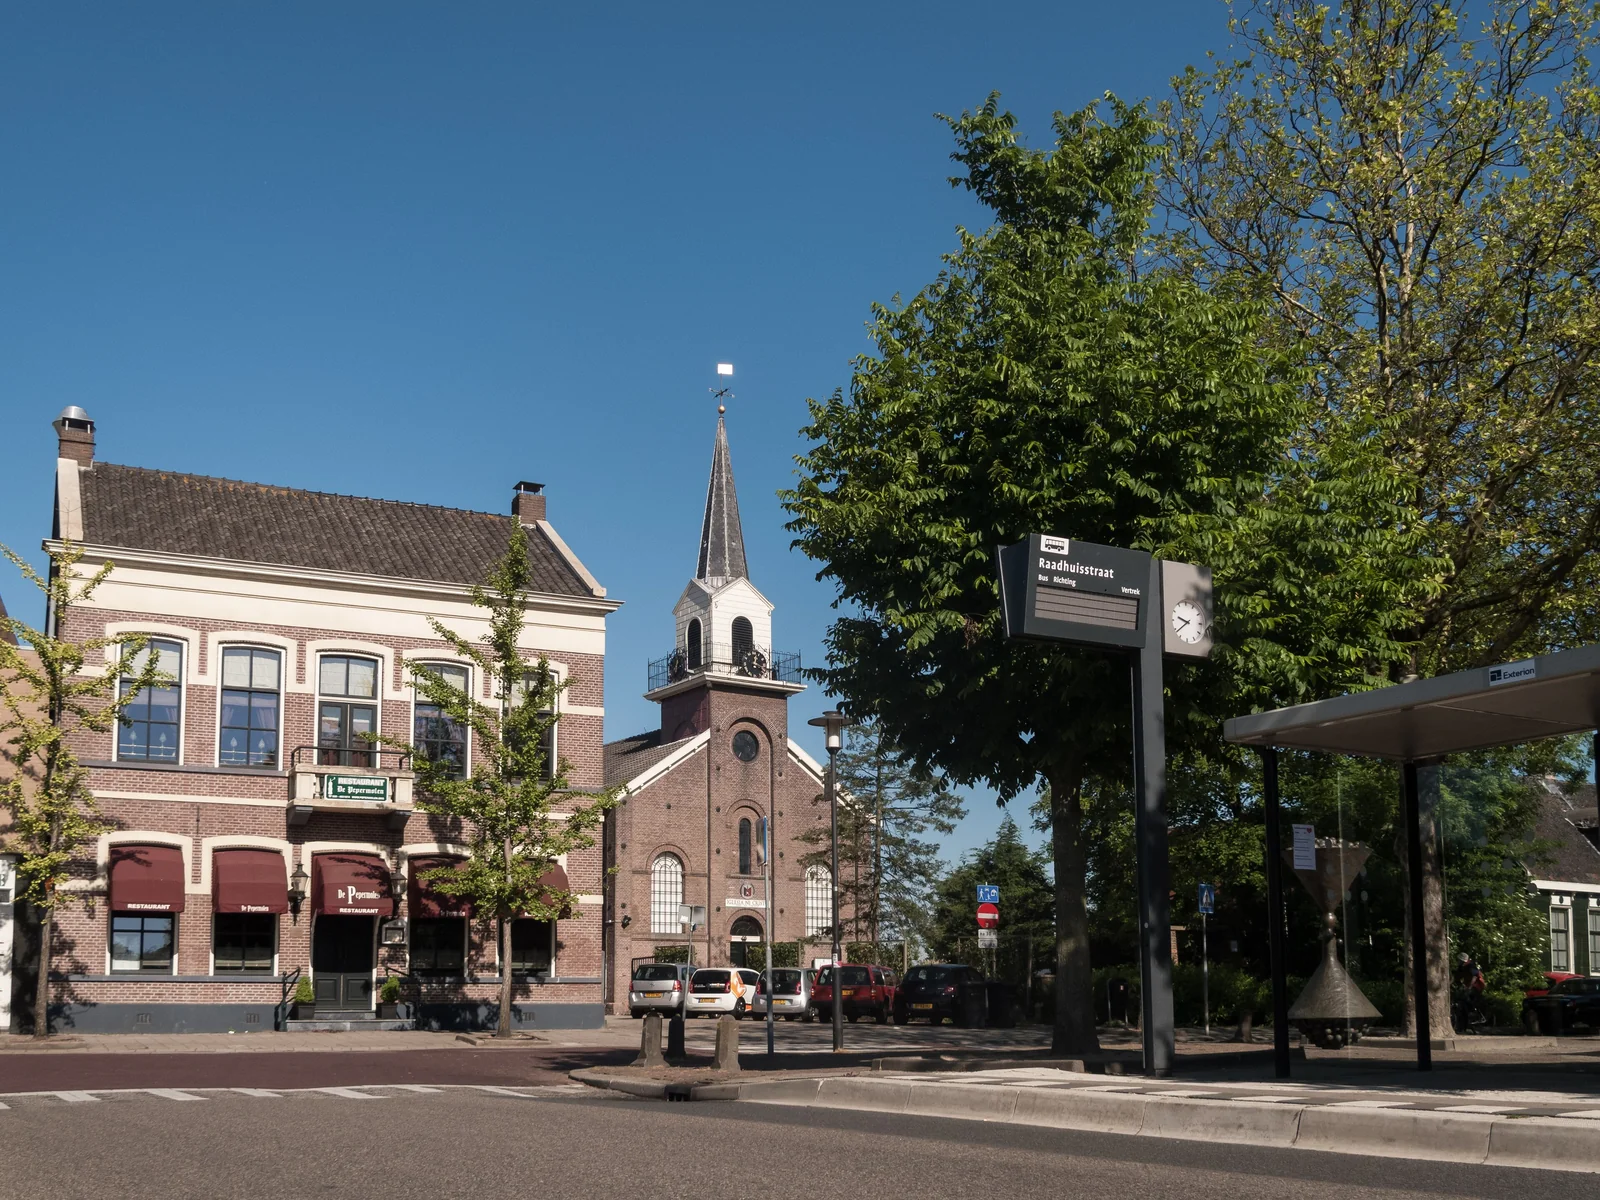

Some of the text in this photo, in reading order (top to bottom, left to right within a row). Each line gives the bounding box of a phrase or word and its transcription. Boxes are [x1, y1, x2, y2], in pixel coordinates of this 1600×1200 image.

[1039, 557, 1114, 579] Raadhuisstraat
[1038, 574, 1077, 587] Bus Richting
[1121, 586, 1141, 596] Vertrek
[1503, 668, 1535, 680] Exterion
[337, 777, 386, 787] RESTAURANT
[337, 785, 385, 795] De Pepermolen
[337, 889, 346, 899] De
